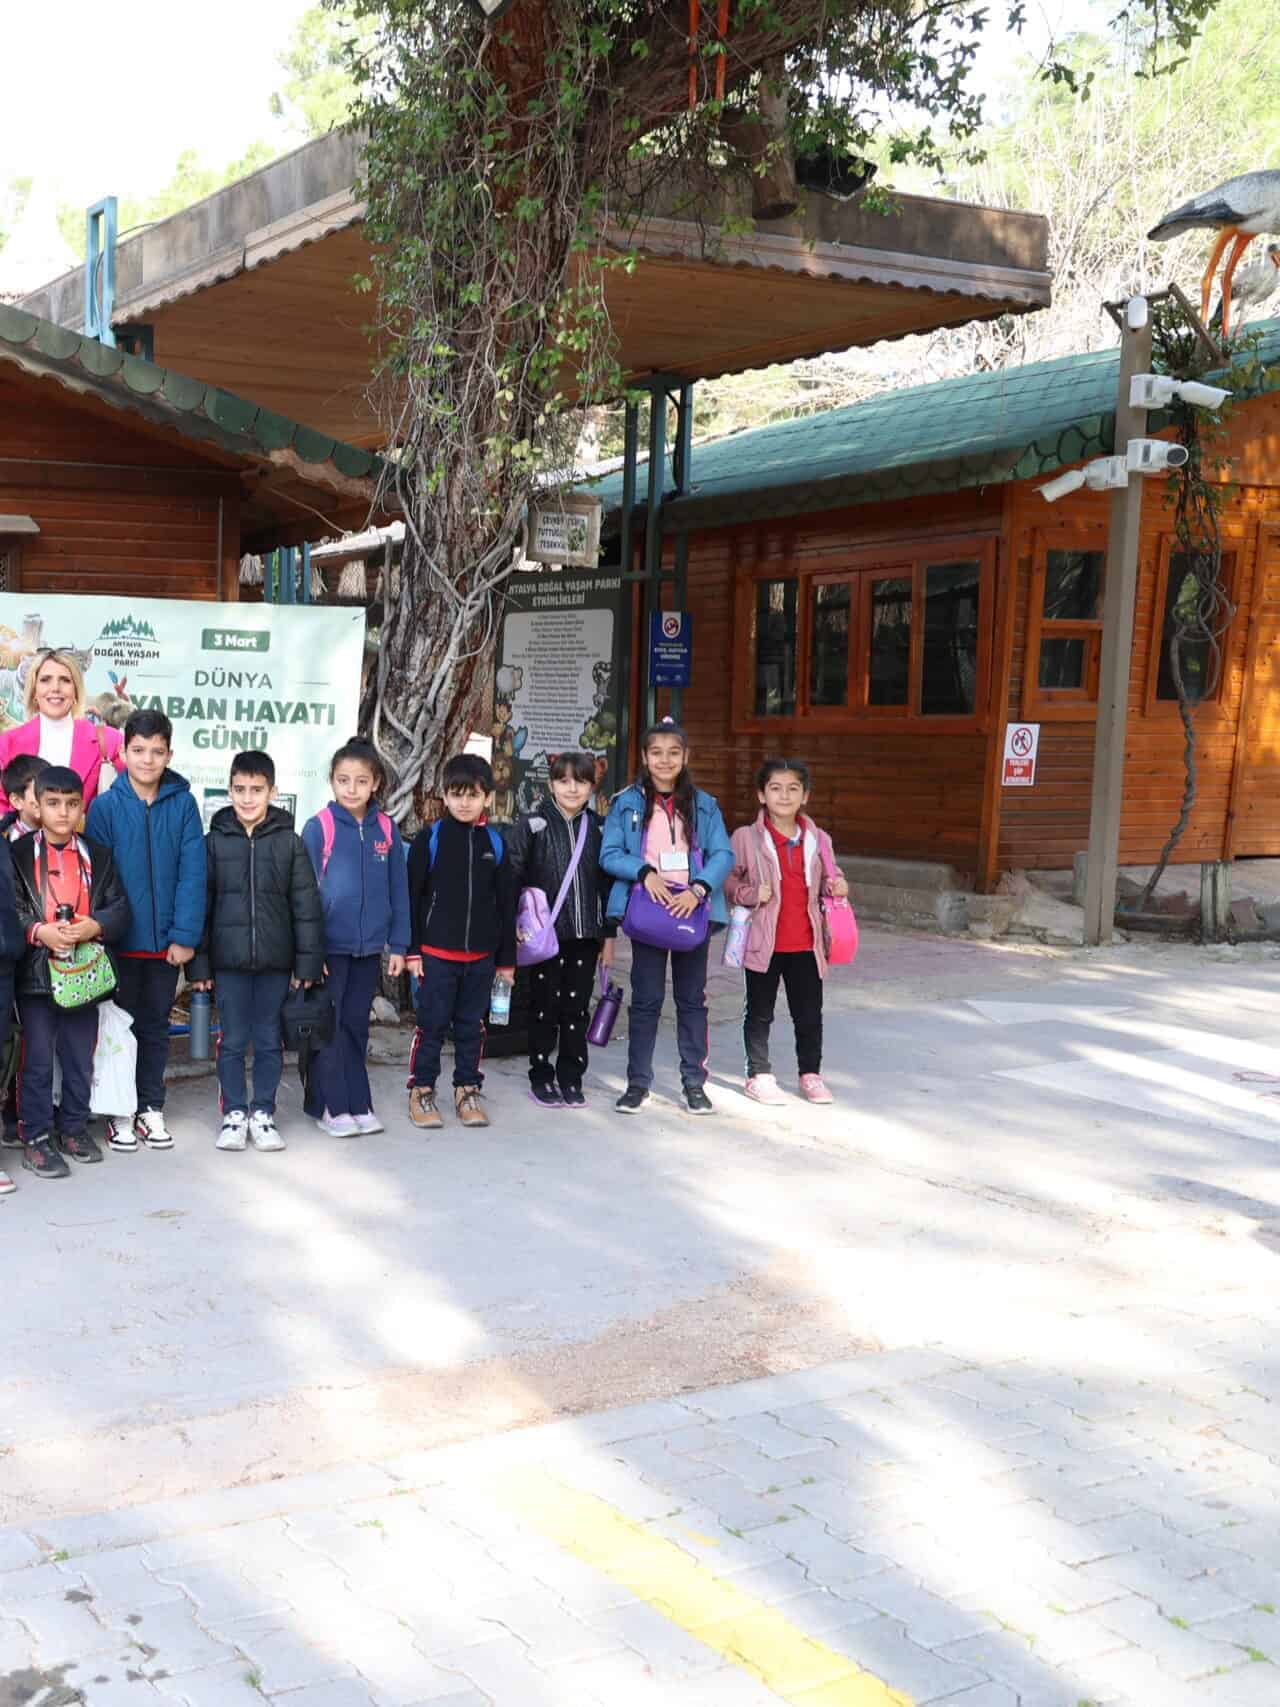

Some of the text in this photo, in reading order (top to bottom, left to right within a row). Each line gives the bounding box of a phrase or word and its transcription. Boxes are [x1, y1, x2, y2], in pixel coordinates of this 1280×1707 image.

[508, 583, 537, 595] NTALYA
[214, 634, 258, 649] 3 Mart
[194, 667, 272, 689] DÜNYA
[235, 700, 336, 726] HAYATI
[192, 725, 268, 752] GÜNÜ
